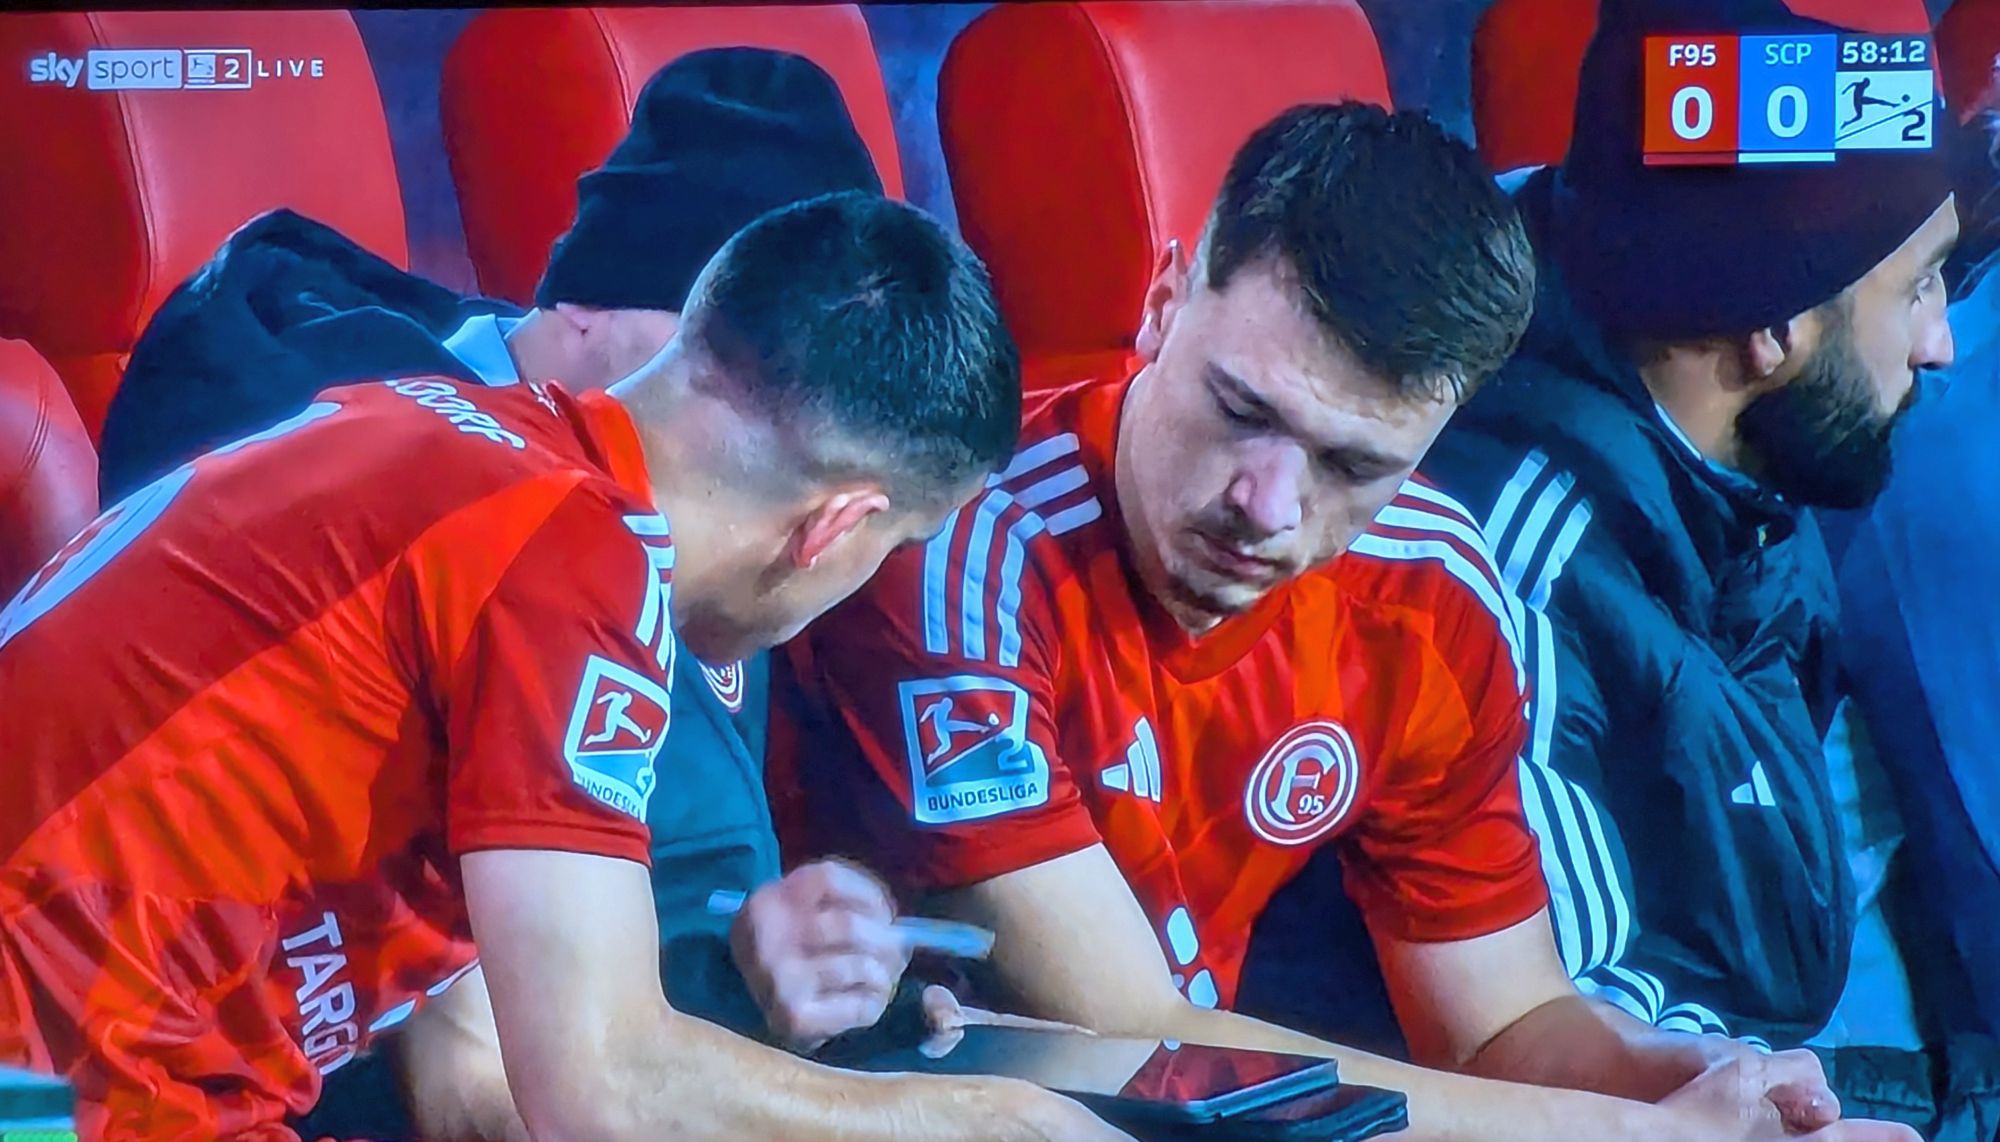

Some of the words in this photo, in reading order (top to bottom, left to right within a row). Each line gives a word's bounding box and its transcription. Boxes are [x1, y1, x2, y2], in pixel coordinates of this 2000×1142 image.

[1668, 44, 1717, 67] F95
[1764, 43, 1812, 65] SCP
[1841, 40, 1927, 64] 58:12
[30, 52, 84, 88] sky
[94, 56, 175, 83] sport
[224, 58, 241, 79] 2
[256, 60, 324, 78] LIVE
[1671, 86, 1713, 140] 0
[1766, 85, 1809, 138] 0
[1901, 108, 1926, 142] 2
[927, 782, 1038, 811] BUNDESLIGA
[1297, 794, 1325, 815] 95
